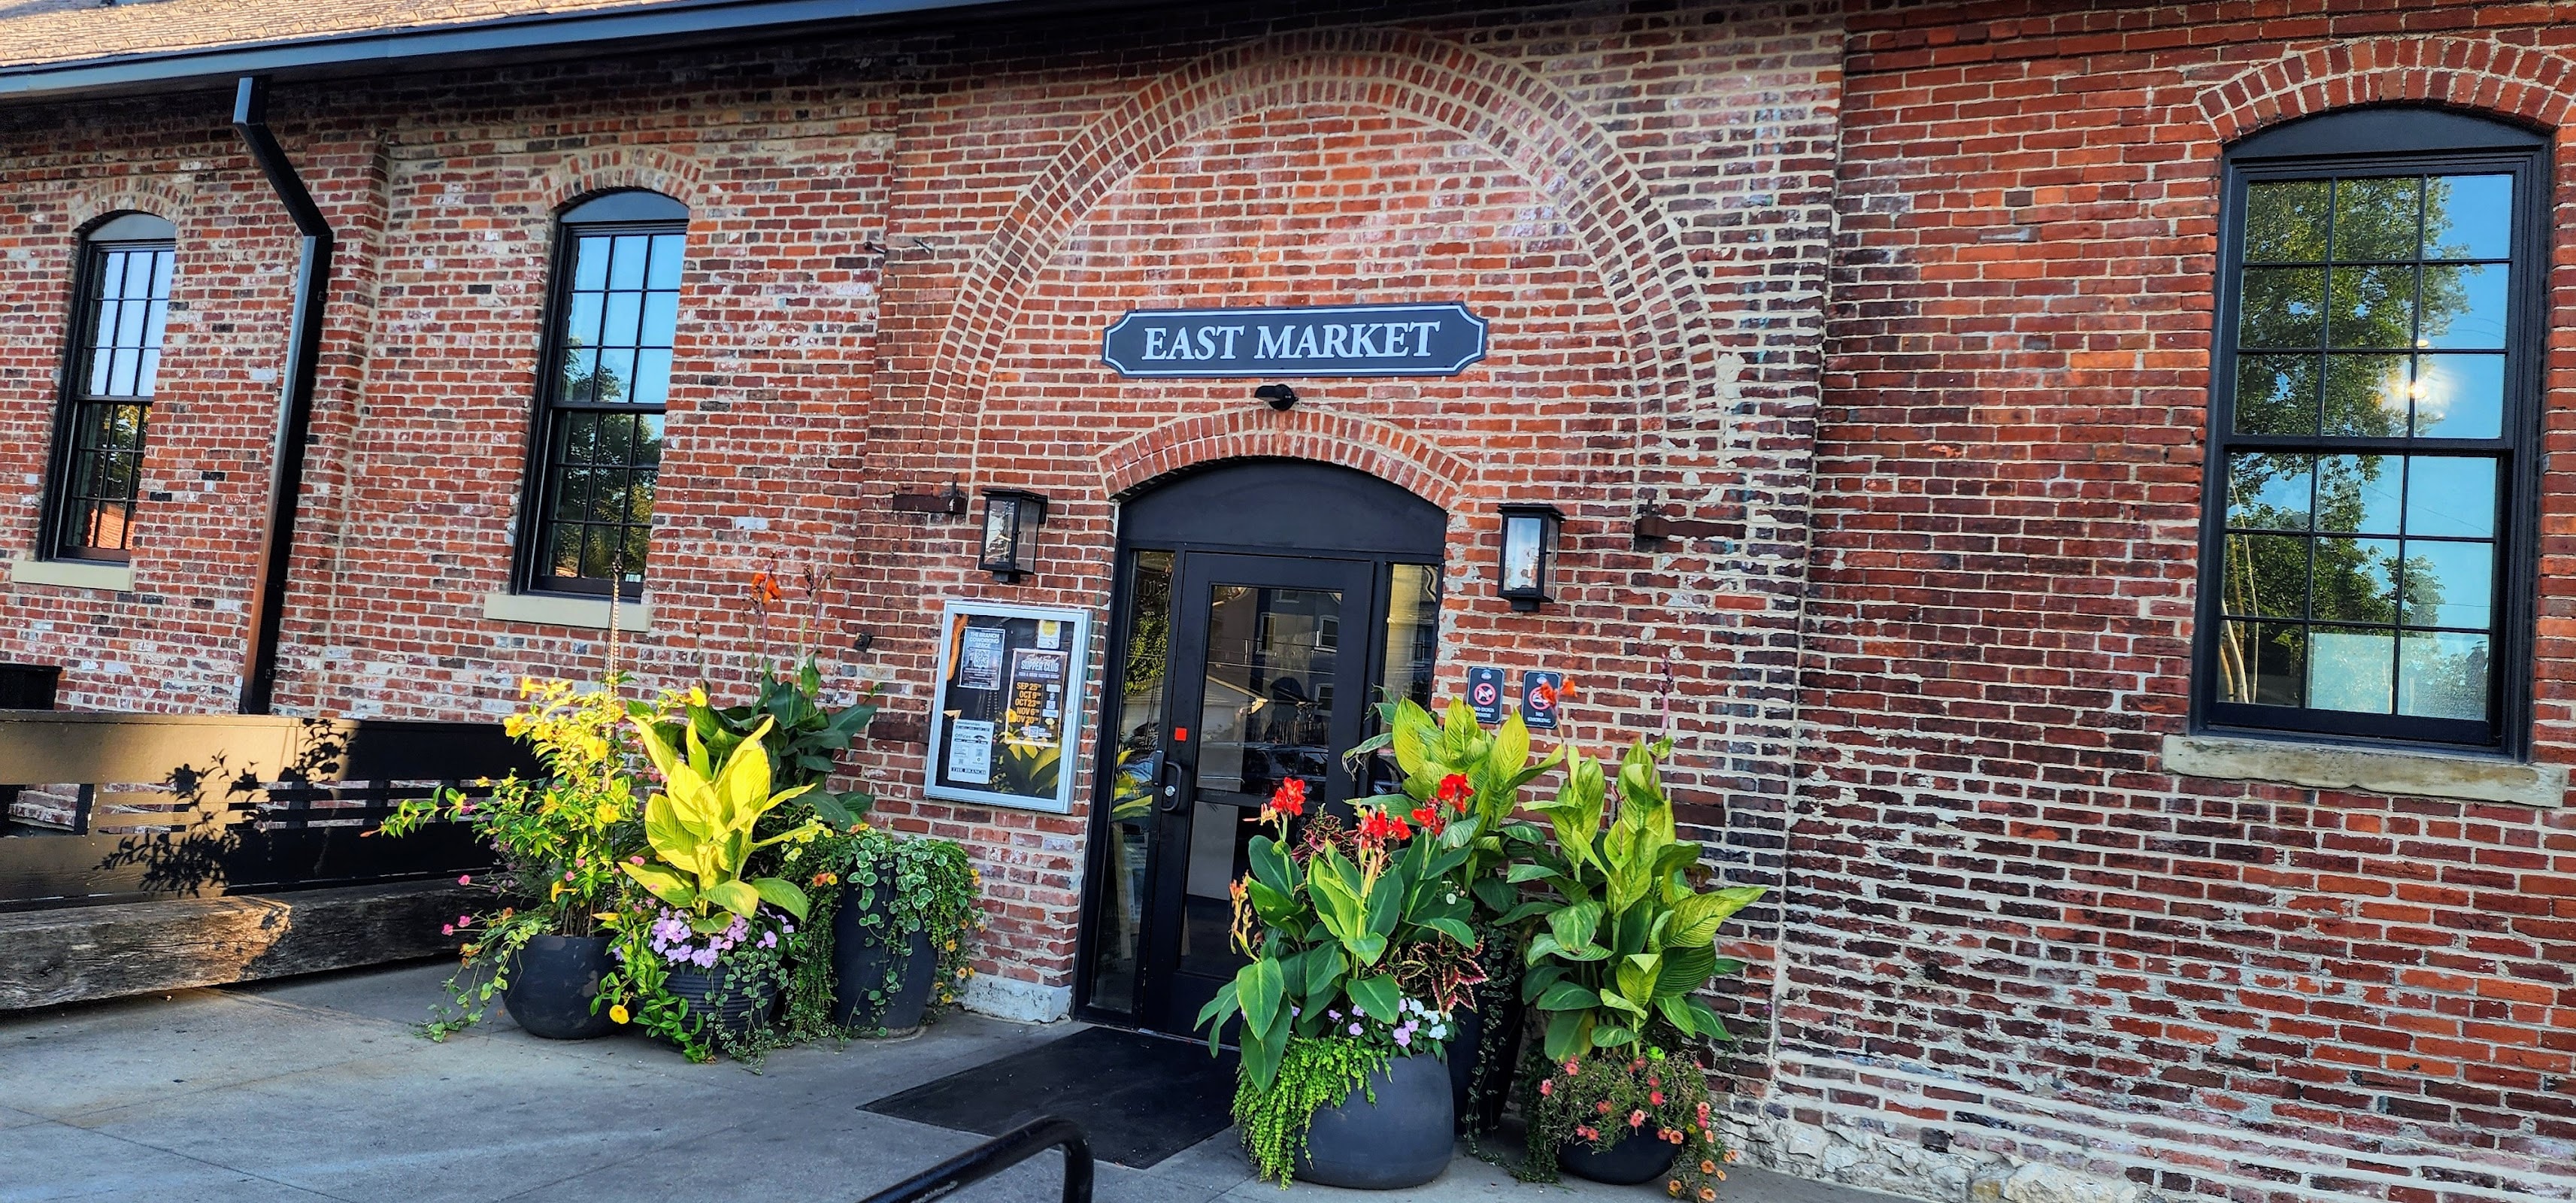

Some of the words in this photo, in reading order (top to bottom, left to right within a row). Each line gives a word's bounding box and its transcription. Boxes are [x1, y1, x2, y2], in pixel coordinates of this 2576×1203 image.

[1141, 325, 1245, 362] EAST
[1253, 320, 1442, 360] MARKET
[1020, 660, 1043, 671] SUPPER
[1044, 662, 1059, 672] CLUB
[1016, 681, 1029, 690] SEP
[1019, 690, 1032, 698] OCT
[1014, 698, 1028, 707] OCT
[1017, 707, 1030, 715] NOV
[1017, 714, 1026, 723] OV
